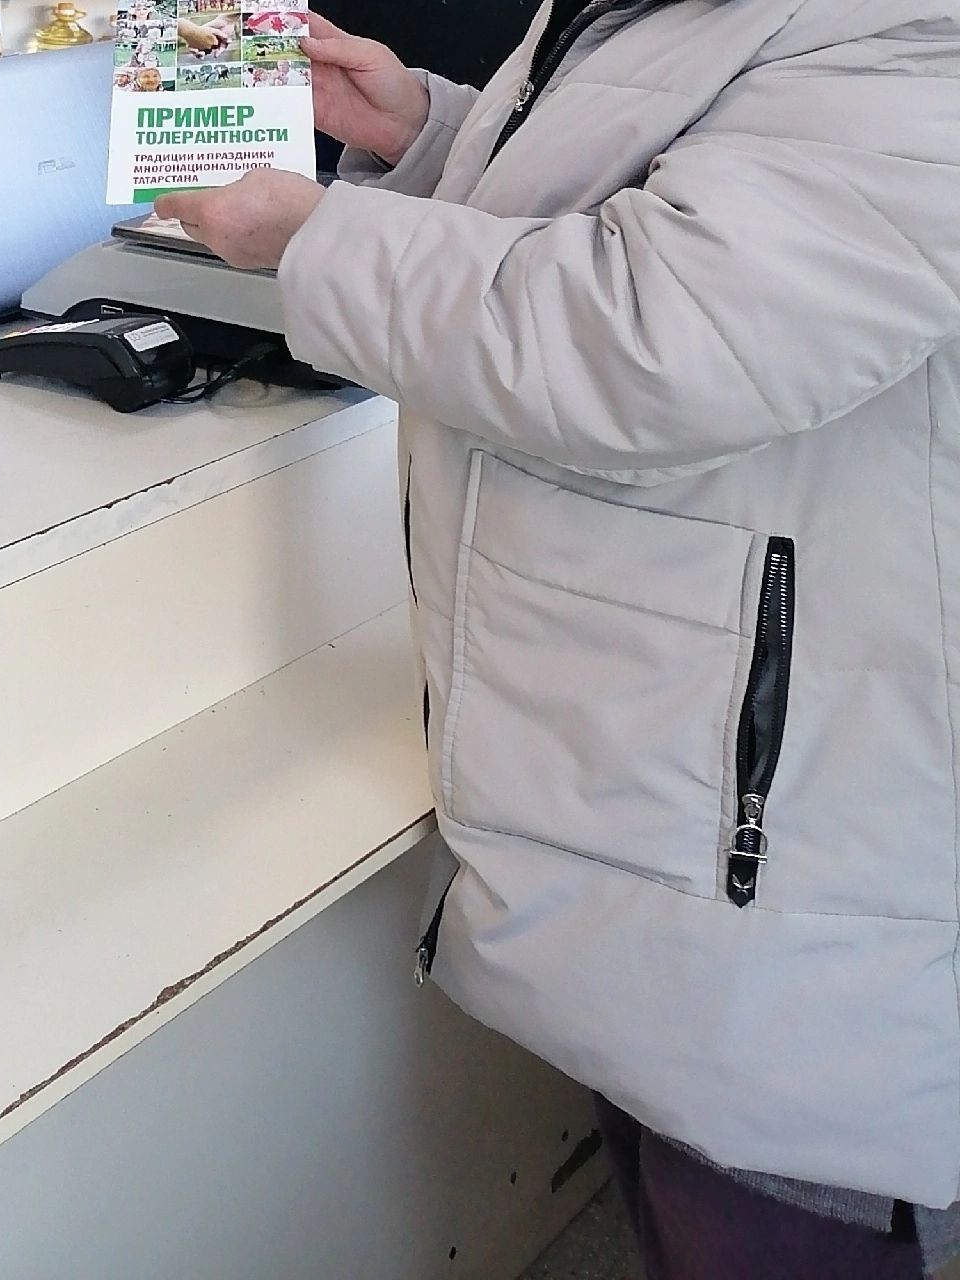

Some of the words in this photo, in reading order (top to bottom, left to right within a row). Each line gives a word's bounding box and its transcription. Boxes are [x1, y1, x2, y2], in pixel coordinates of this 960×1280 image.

[137, 105, 255, 128] ПРИМЕР
[135, 128, 289, 145] ТОЛЕРАНТНОСТИ
[134, 152, 194, 163] ТРАДИЦИИ
[197, 153, 205, 161] И
[207, 151, 275, 162] ПРАЗДНИКИ
[133, 162, 272, 174] МНОГОНАЦИОНАЛЬНОГО
[133, 175, 199, 185] ТАТАРСТАНА
